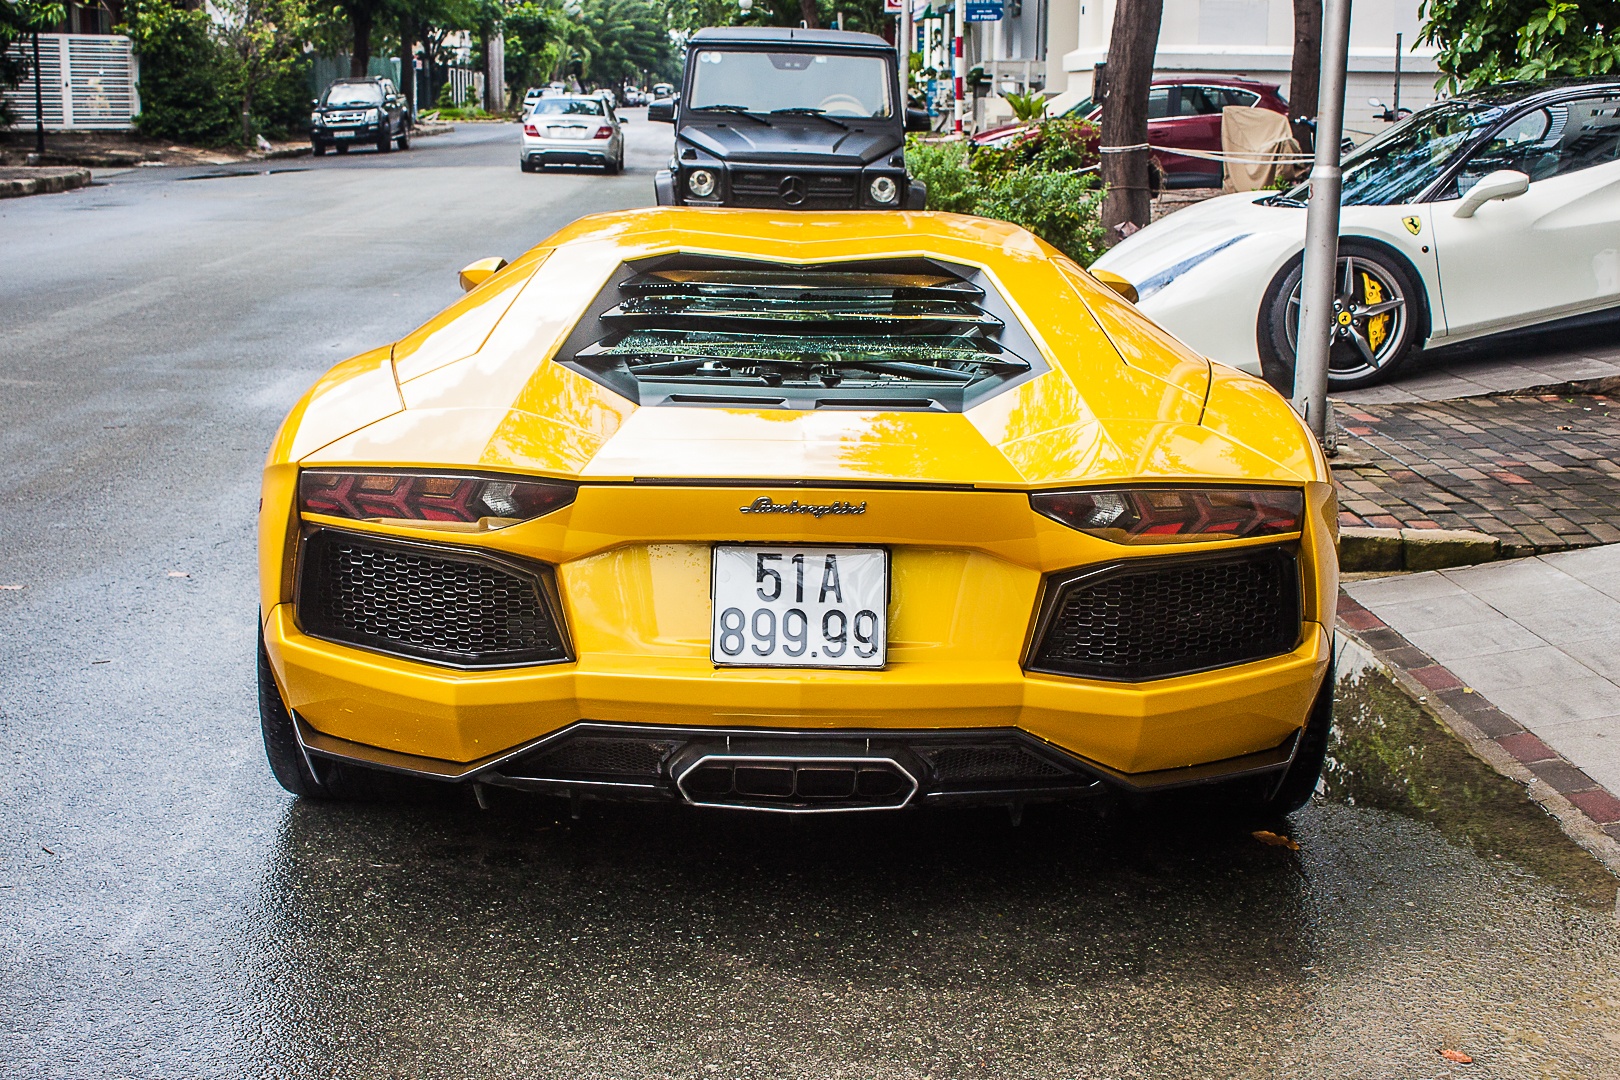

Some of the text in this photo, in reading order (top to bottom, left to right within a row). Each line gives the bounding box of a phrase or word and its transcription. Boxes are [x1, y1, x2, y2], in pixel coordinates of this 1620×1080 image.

[740, 496, 867, 518] Lamborghini
[756, 553, 843, 603] 51A
[720, 607, 879, 659] 899.99
